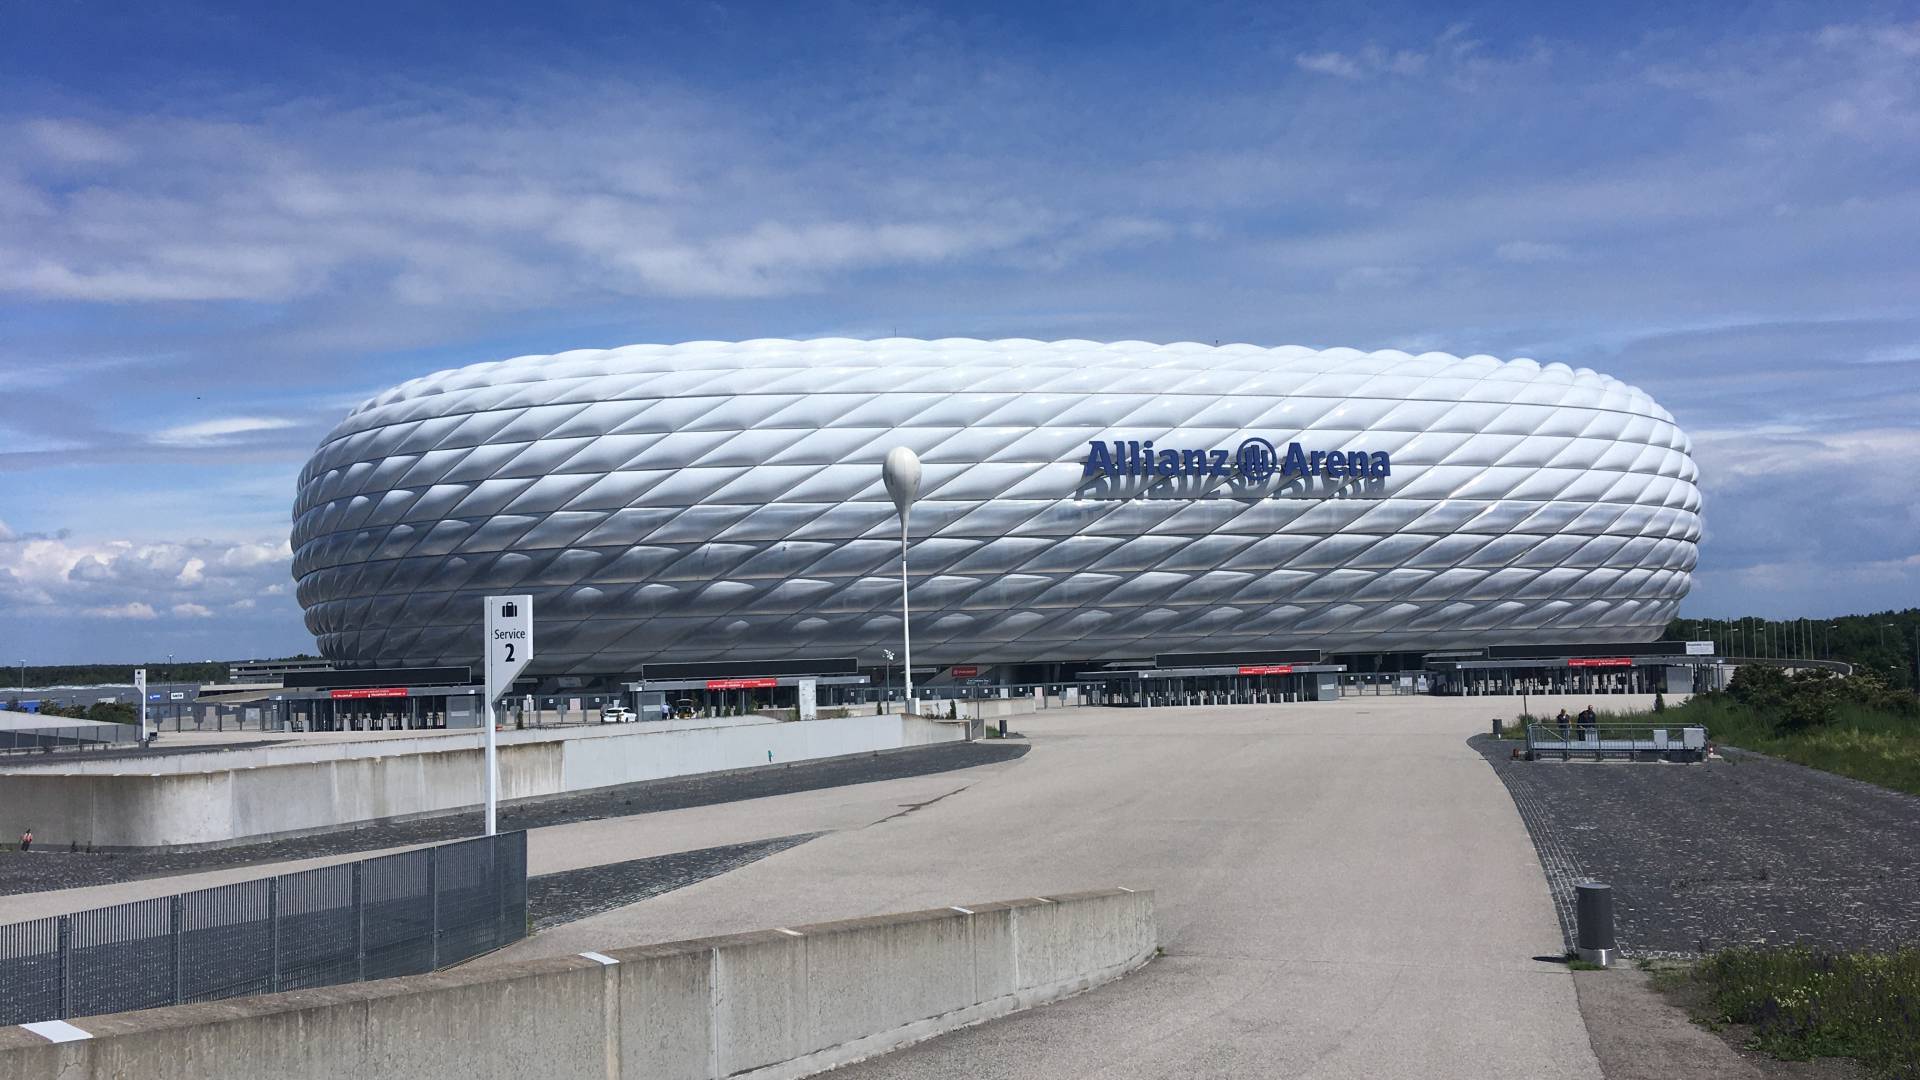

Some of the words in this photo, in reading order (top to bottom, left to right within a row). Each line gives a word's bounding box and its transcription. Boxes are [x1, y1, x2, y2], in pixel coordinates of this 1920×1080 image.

[1085, 440, 1230, 477] Allianz
[1282, 442, 1391, 478] Arena
[494, 628, 526, 640] Service
[505, 643, 515, 662] 2
